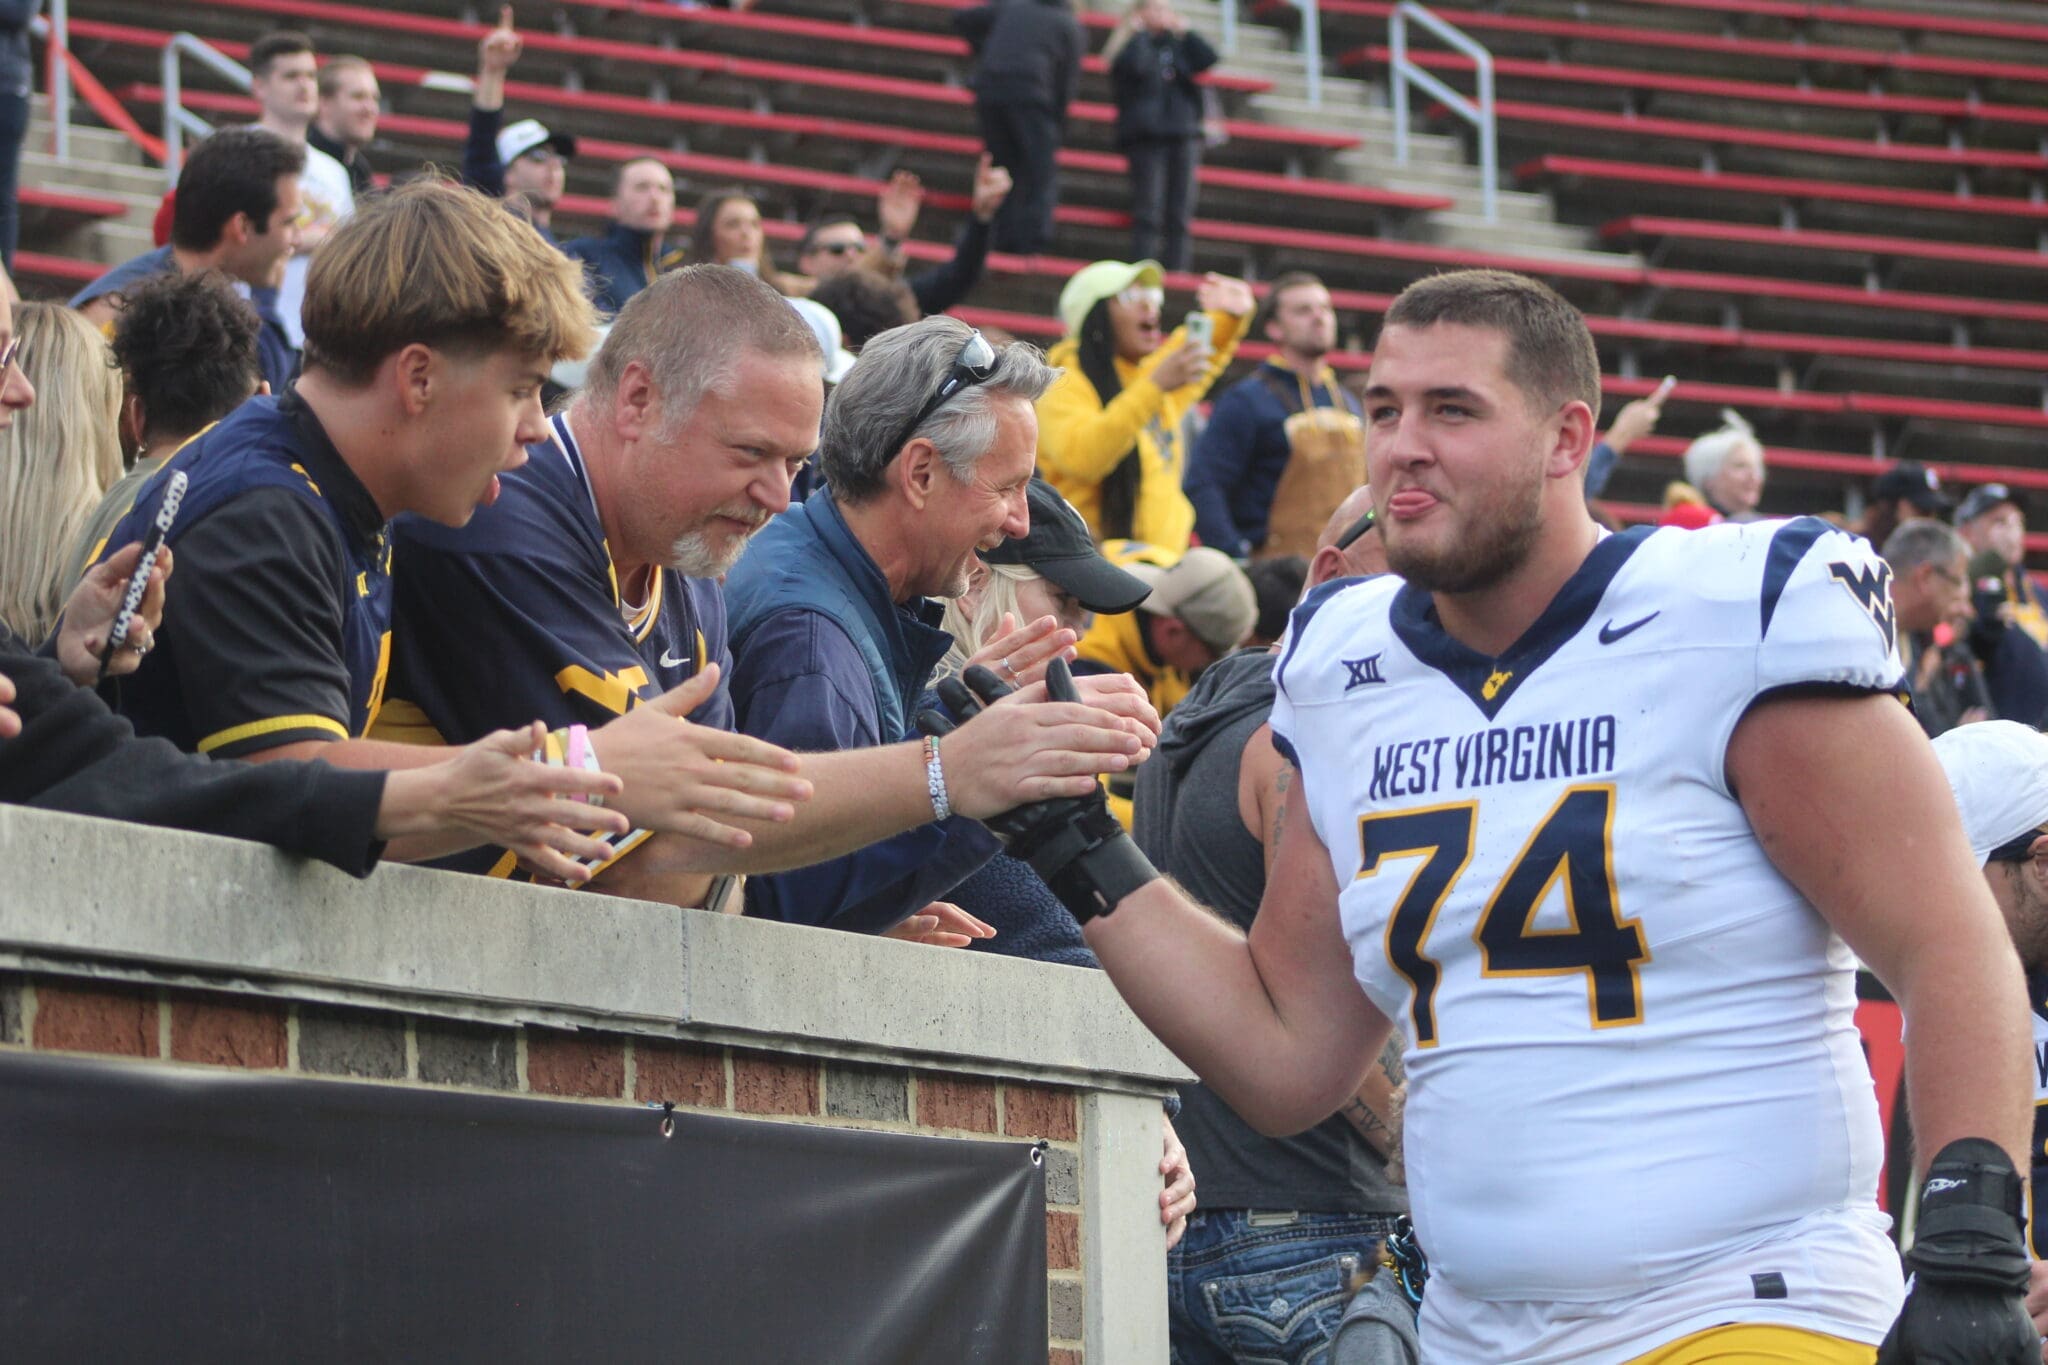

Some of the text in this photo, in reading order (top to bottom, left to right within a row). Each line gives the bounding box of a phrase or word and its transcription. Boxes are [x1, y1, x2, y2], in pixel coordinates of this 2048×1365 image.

[1341, 652, 1386, 691] XII
[1369, 714, 1615, 801] WEST VIRGINIA
[1355, 782, 1653, 1050] 74
